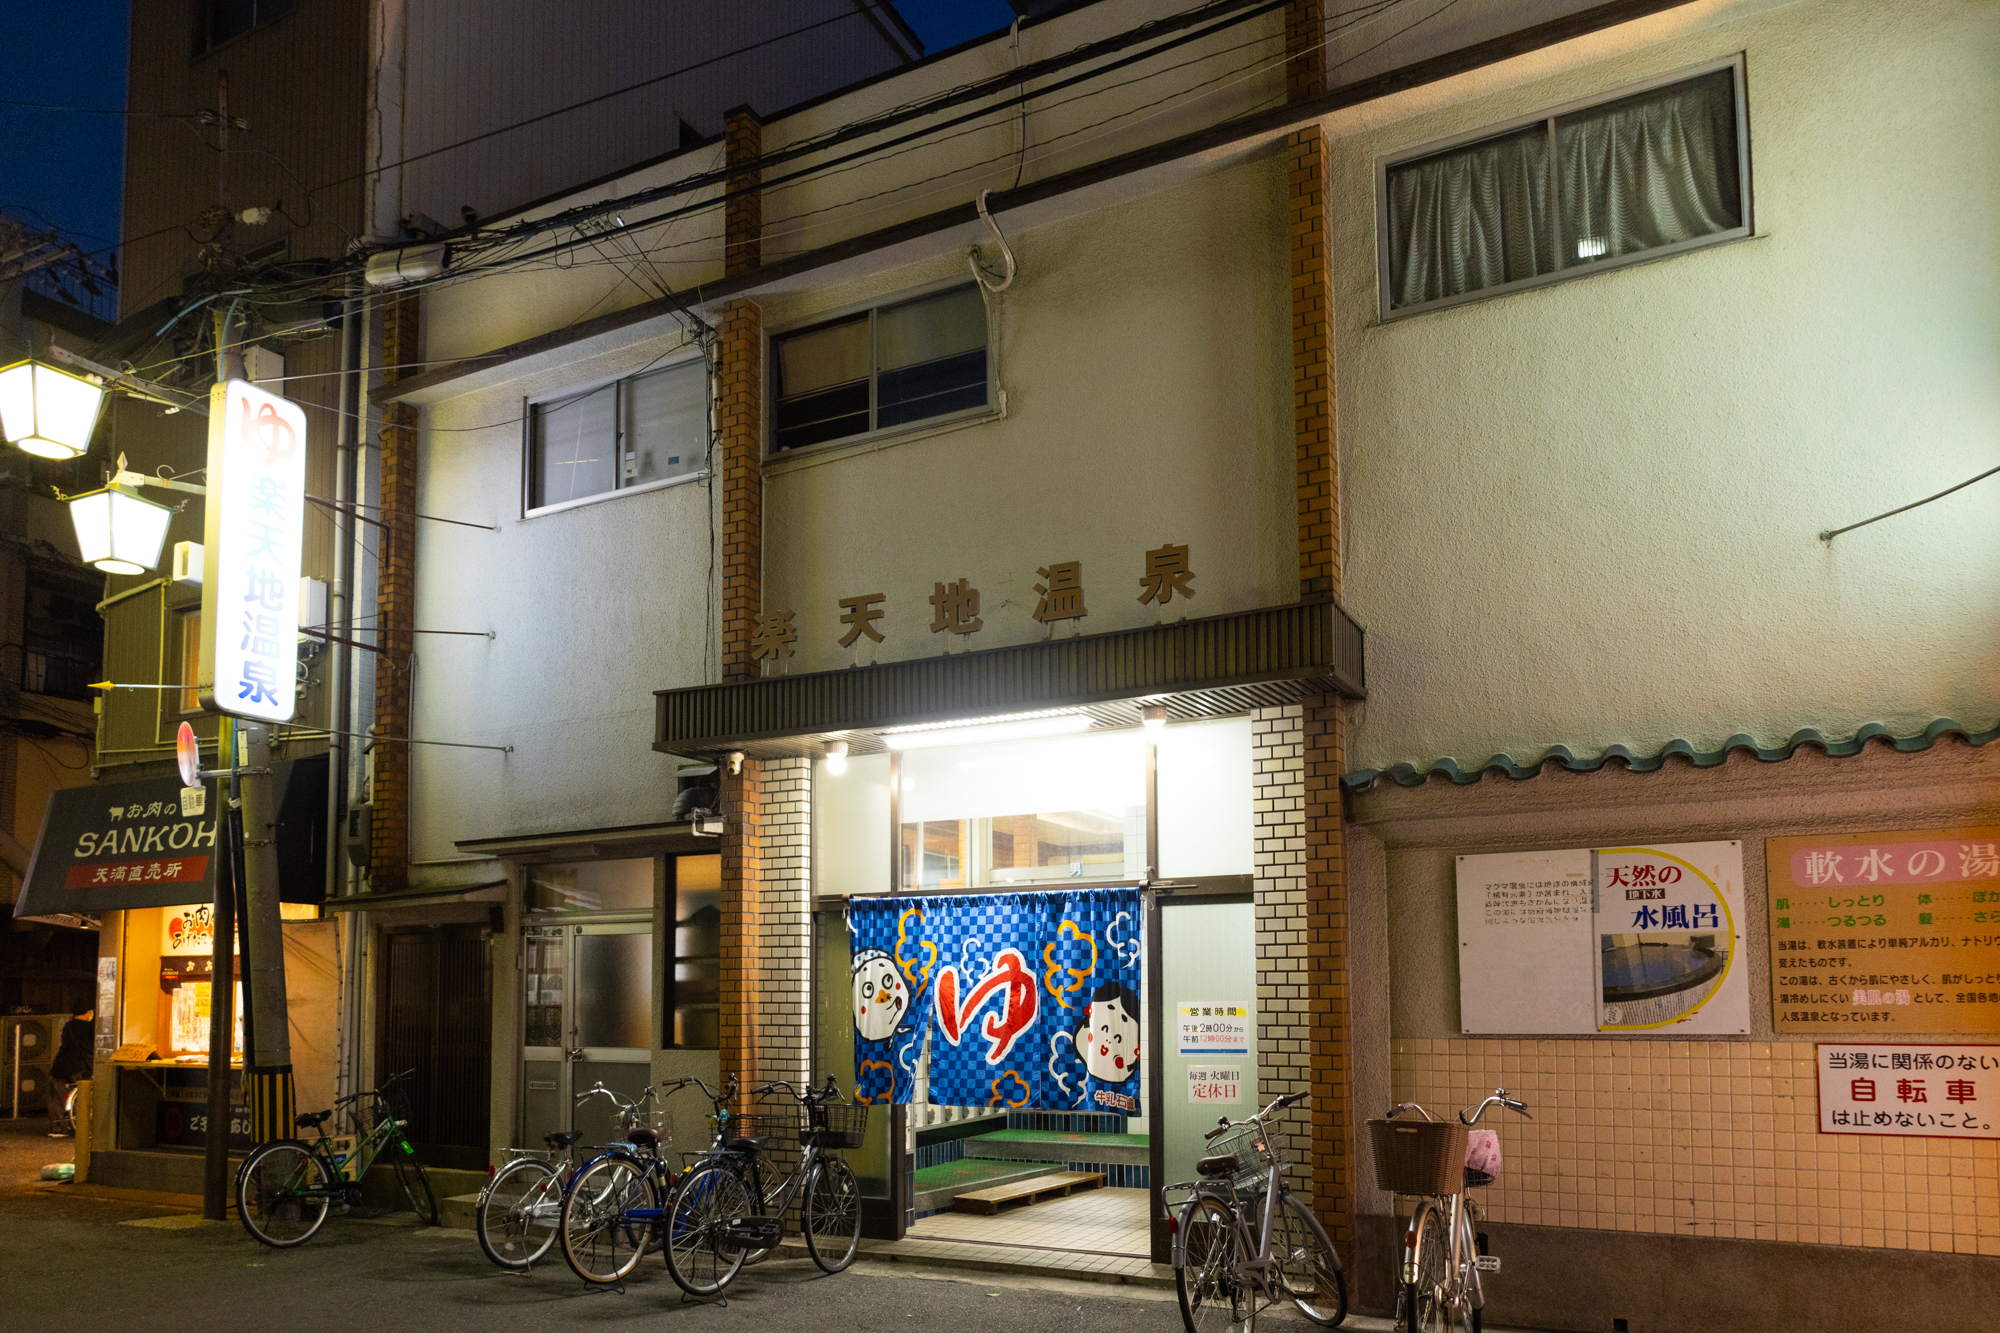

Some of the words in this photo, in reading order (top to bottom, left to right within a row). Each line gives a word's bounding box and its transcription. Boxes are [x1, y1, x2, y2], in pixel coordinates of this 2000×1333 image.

[241, 396, 297, 466] ゆ
[238, 470, 287, 708] 楽天地温泉
[750, 543, 1196, 662] 楽天地温泉
[126, 802, 177, 819] お肉の
[74, 821, 217, 858] SANKOH
[92, 862, 182, 883] 天満直売所
[1070, 862, 1083, 877] 男
[1805, 843, 2000, 884] 軟水の湯
[1605, 865, 1682, 888] 天然の
[1628, 889, 1662, 900] 地下水
[1631, 903, 1719, 930] 水風呂
[1779, 957, 1852, 968] 変えたものです。
[934, 947, 1037, 1065] ゆ
[1852, 989, 1910, 1005] 美肌の湯
[1190, 1007, 1236, 1016] 営業時間
[1781, 1011, 1895, 1022] 人気温泉となっています。
[1829, 1052, 1999, 1070] 当湯に関係のない
[1189, 1071, 1207, 1080] 毎週
[1210, 1071, 1239, 1080] 火曜日
[1193, 1083, 1236, 1098] 定休日
[1851, 1077, 1977, 1104] 自転車
[1832, 1110, 1990, 1130] は止めないこと。
